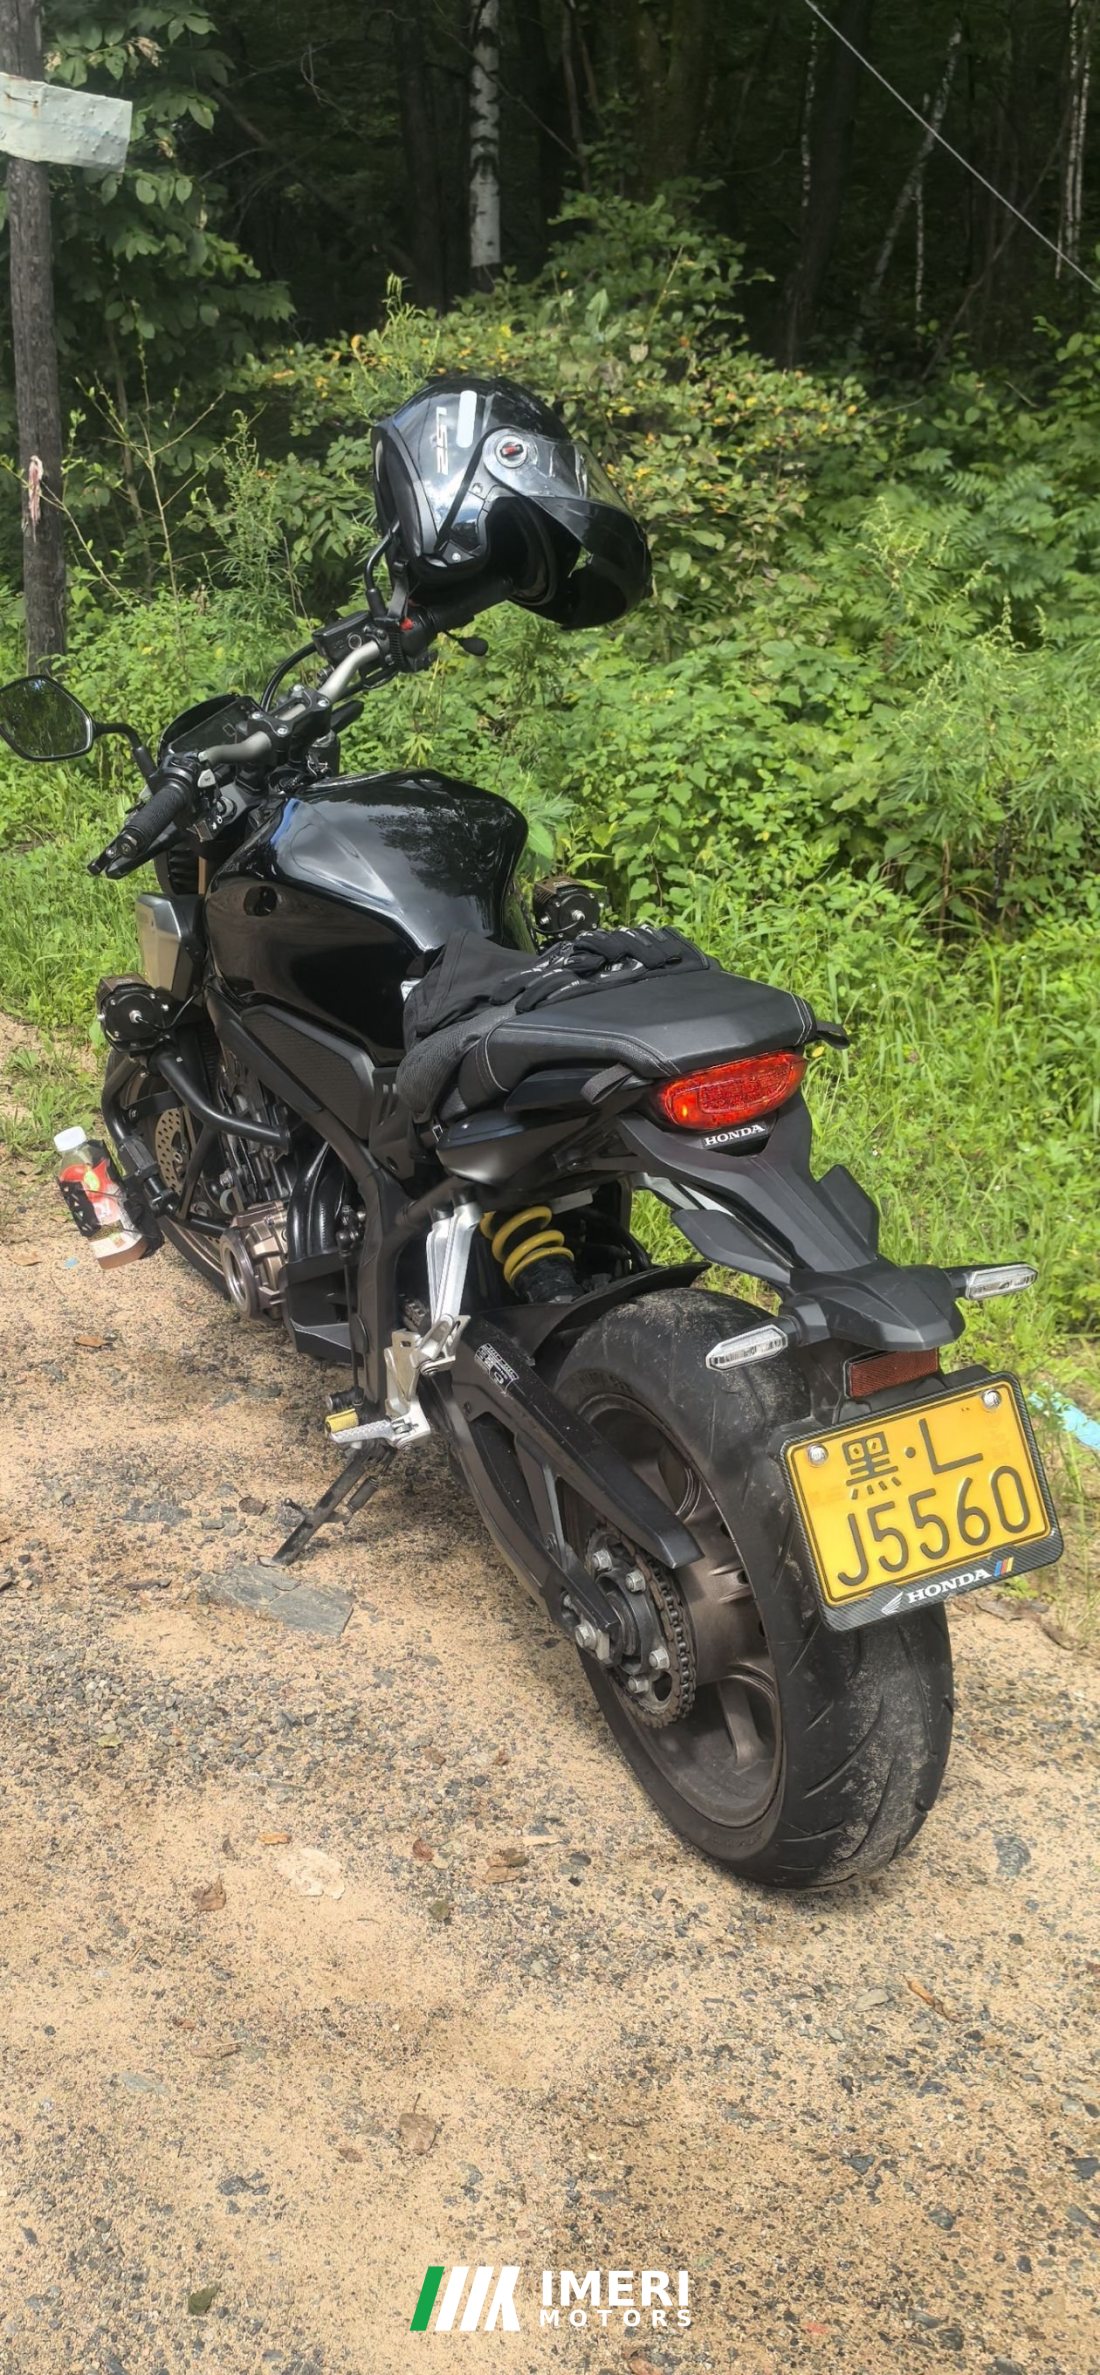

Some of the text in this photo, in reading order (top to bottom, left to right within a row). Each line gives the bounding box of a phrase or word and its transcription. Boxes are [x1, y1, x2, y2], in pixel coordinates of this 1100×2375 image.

[703, 1124, 766, 1146] HONDA
[837, 1465, 1031, 1587] J5560
[906, 1568, 992, 1604] HONDA
